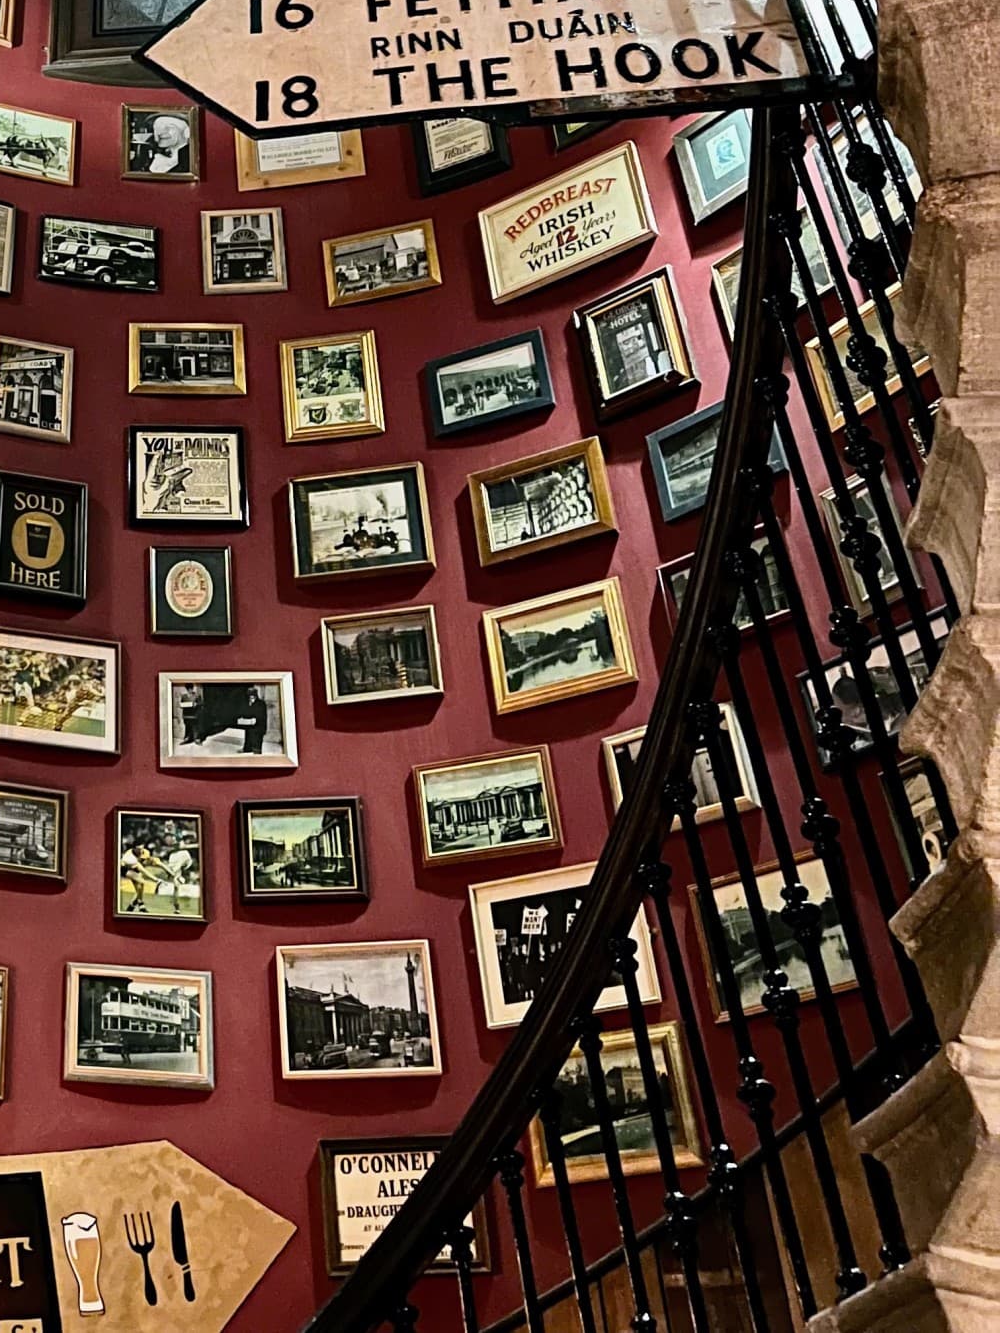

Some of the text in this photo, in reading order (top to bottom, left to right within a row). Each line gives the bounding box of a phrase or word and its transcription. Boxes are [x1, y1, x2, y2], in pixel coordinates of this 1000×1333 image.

[371, 28, 463, 59] RINN
[255, 31, 782, 122] 18 THE HOOK
[503, 177, 617, 244] REDBREAST
[538, 201, 595, 237] IRISH
[519, 209, 616, 260] Aged 12 Years
[526, 225, 614, 272] WHISKEY
[610, 311, 642, 330] HOTEL
[14, 491, 65, 515] SOLD
[10, 561, 61, 589] HERE
[347, 1204, 402, 1219] DRAUGH
